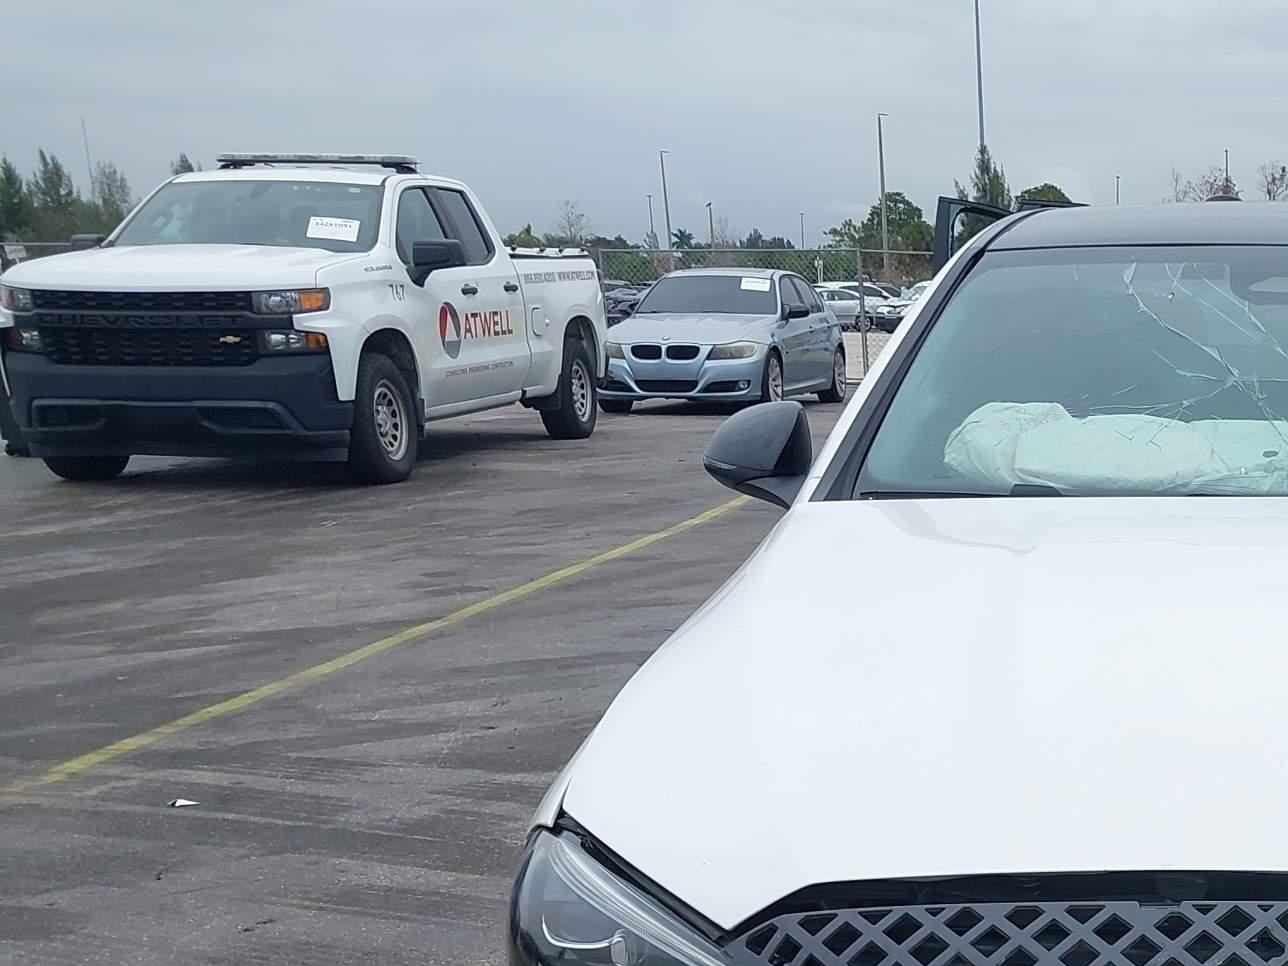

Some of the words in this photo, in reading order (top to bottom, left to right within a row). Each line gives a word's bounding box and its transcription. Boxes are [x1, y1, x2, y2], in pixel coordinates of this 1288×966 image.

[388, 283, 406, 302] 767
[39, 314, 244, 328] CHEVROLET
[464, 309, 514, 340] ATWELL
